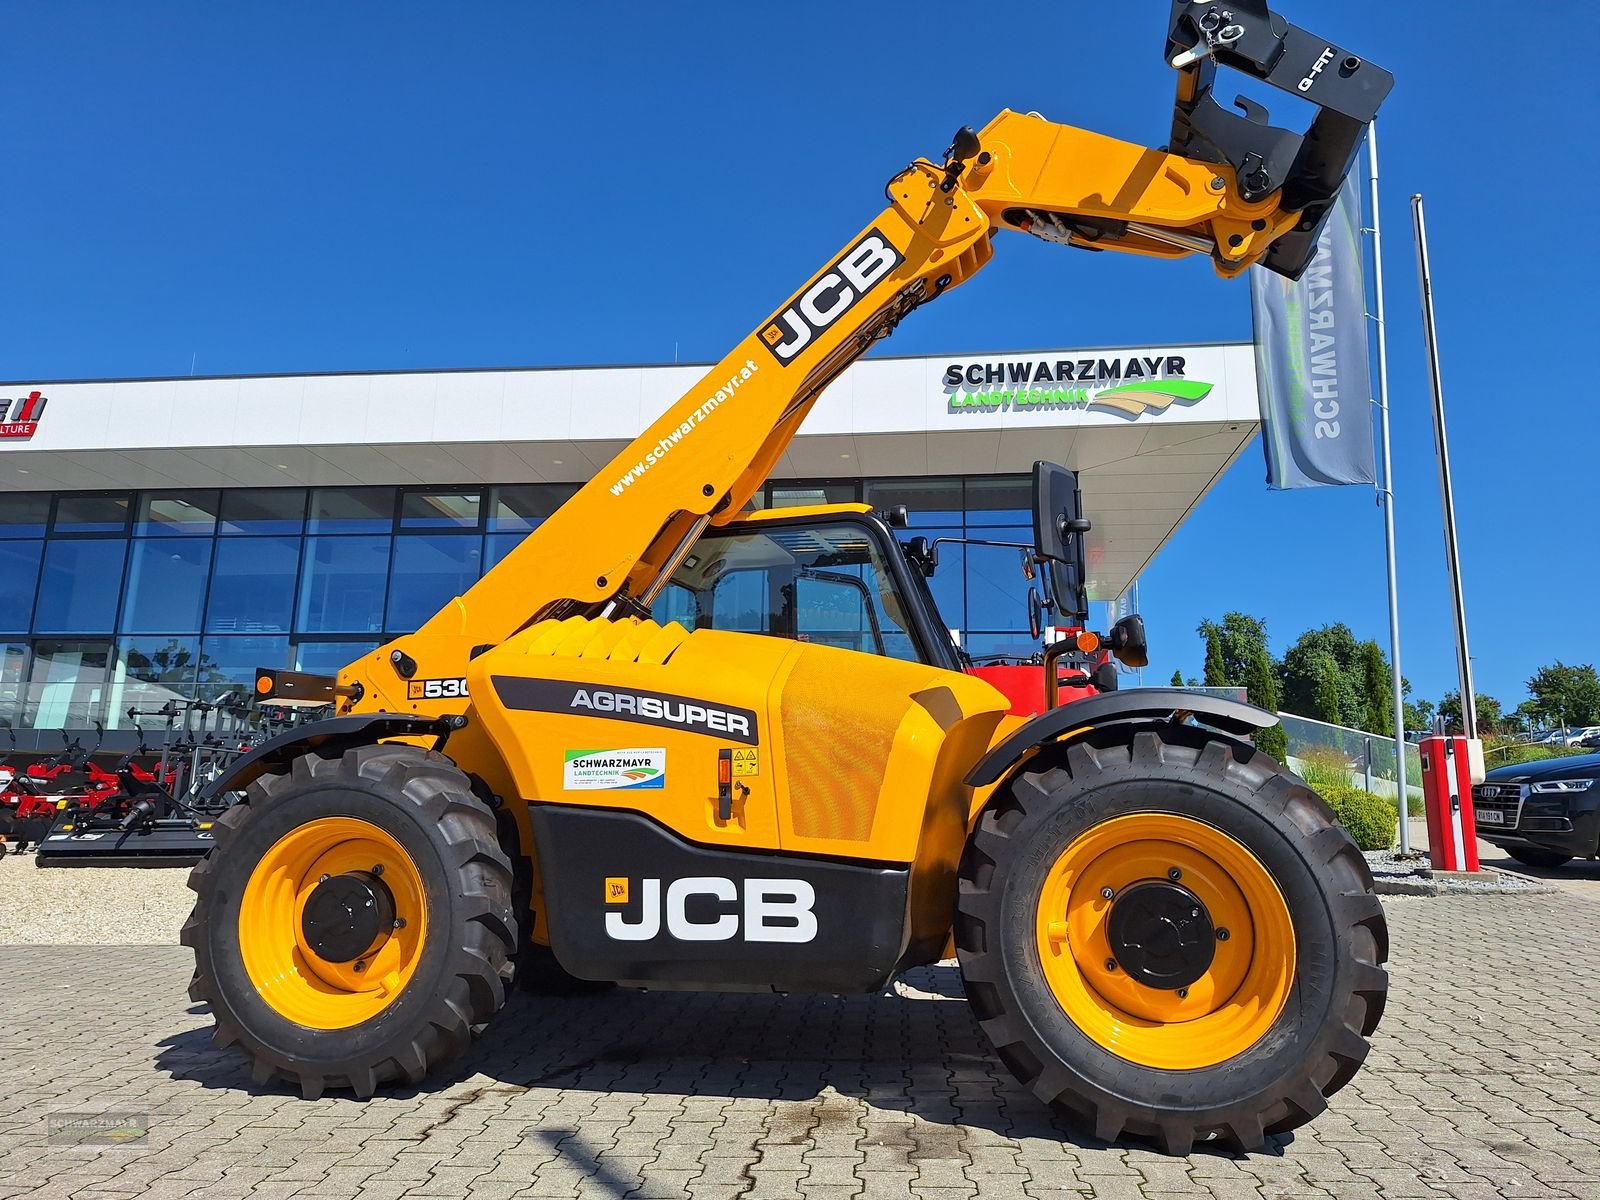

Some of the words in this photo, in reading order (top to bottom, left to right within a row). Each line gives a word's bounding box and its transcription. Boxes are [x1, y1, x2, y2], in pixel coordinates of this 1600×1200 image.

[1297, 47, 1335, 92] Q-FIT
[774, 236, 897, 359] JCB
[946, 355, 1187, 386] SCHWARZMAYR
[950, 387, 1092, 409] LANDTECHNIK
[609, 359, 760, 497] www.schwarzmayr.at
[570, 689, 750, 737] AGRISUPER
[573, 758, 652, 768] SCHWARZMAYR
[574, 769, 620, 777] LANDTECHNIK
[605, 876, 818, 943] JCB
